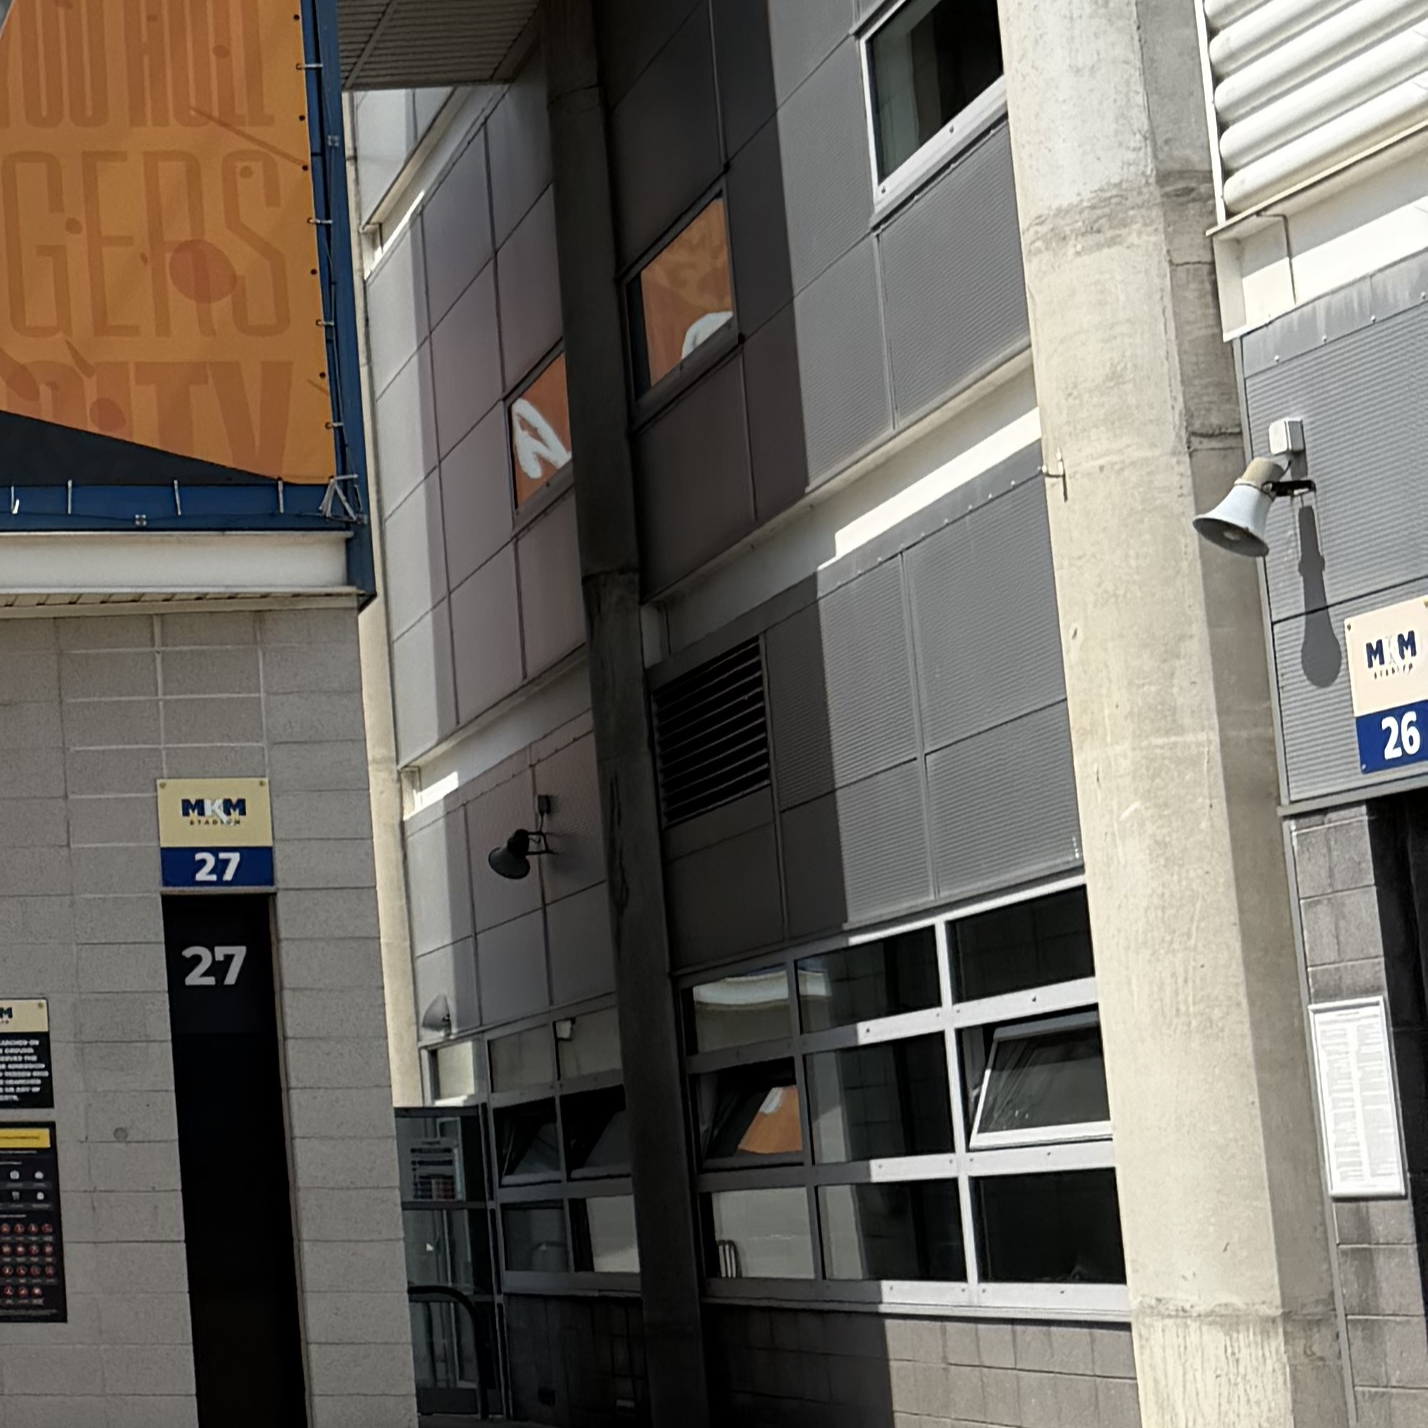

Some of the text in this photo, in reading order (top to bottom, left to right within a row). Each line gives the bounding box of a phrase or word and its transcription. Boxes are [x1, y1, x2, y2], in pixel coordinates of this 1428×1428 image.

[1381, 711, 1421, 760] 26
[181, 798, 246, 826] MKM
[195, 852, 241, 881] 27
[181, 946, 247, 986] 27
